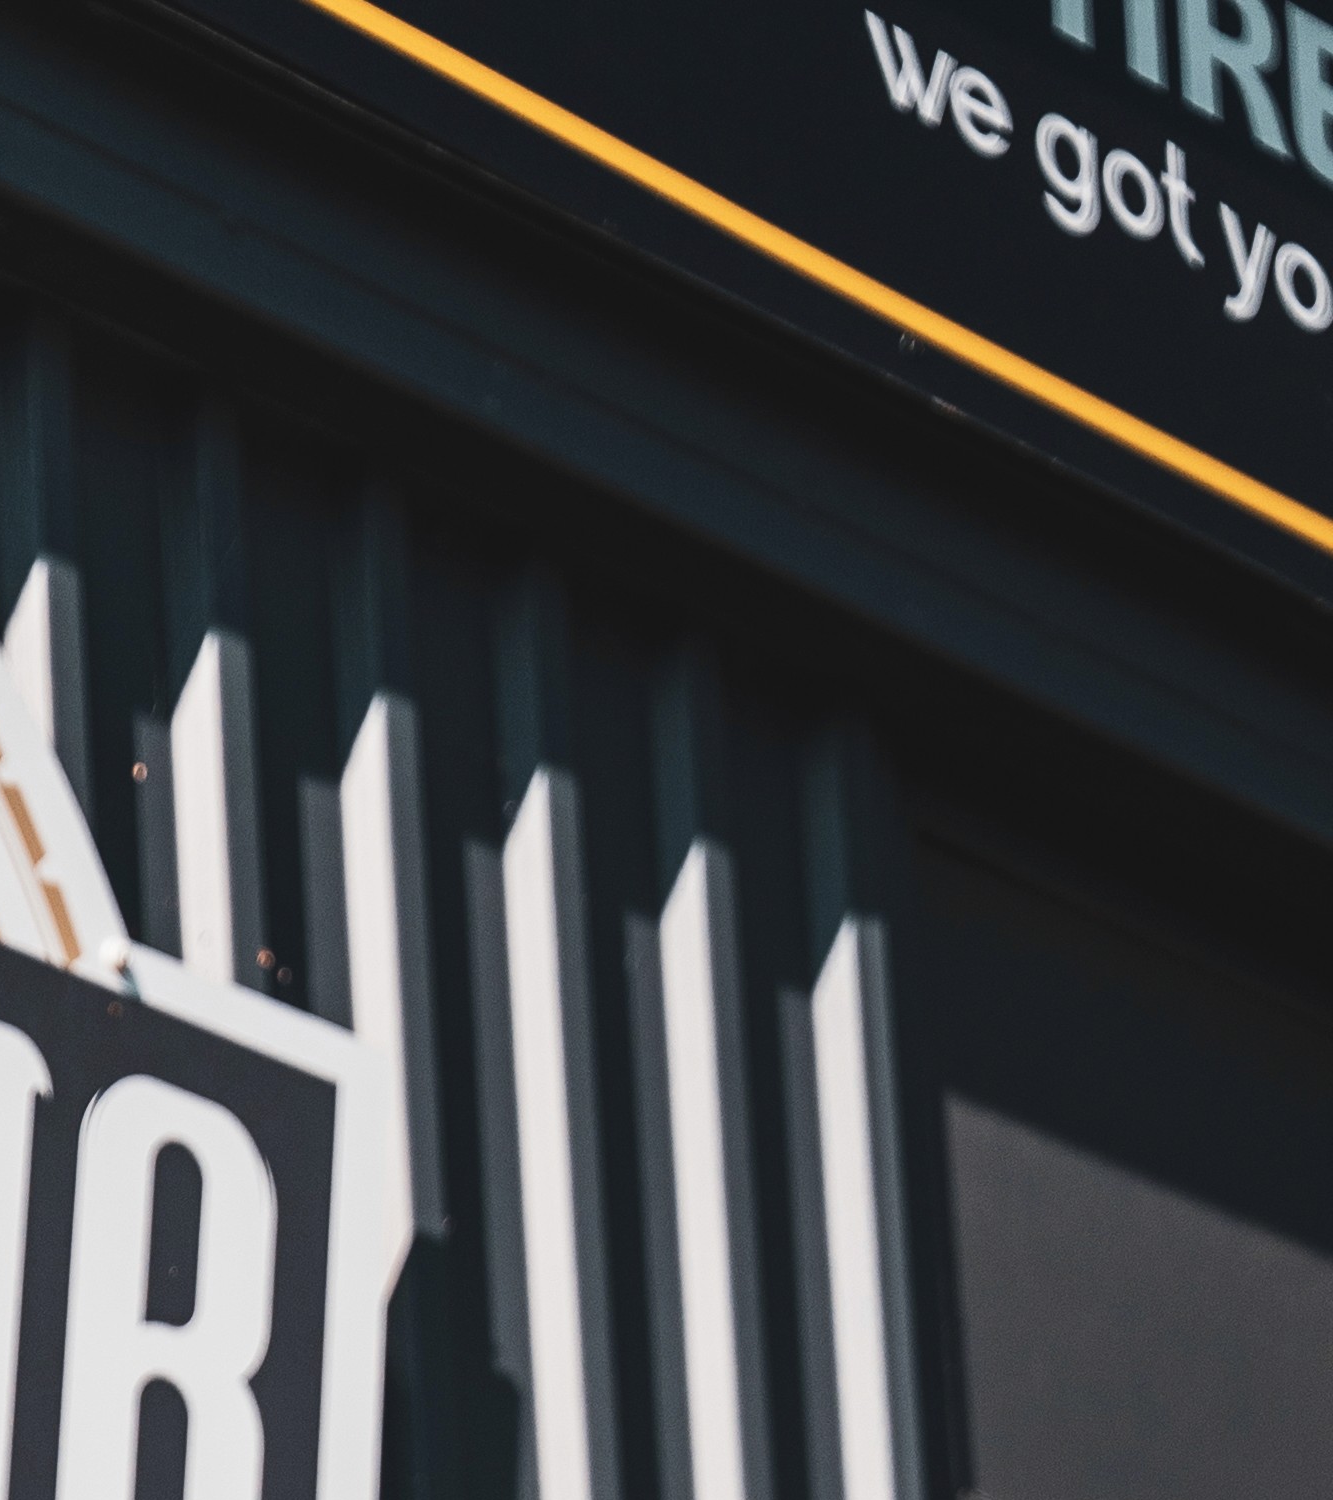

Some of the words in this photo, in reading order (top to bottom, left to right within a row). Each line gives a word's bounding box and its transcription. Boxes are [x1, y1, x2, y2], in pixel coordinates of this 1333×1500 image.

[864, 9, 1013, 158] we
[1036, 112, 1205, 268] got
[1219, 201, 1333, 333] yo
[1050, 0, 1333, 190] IRE
